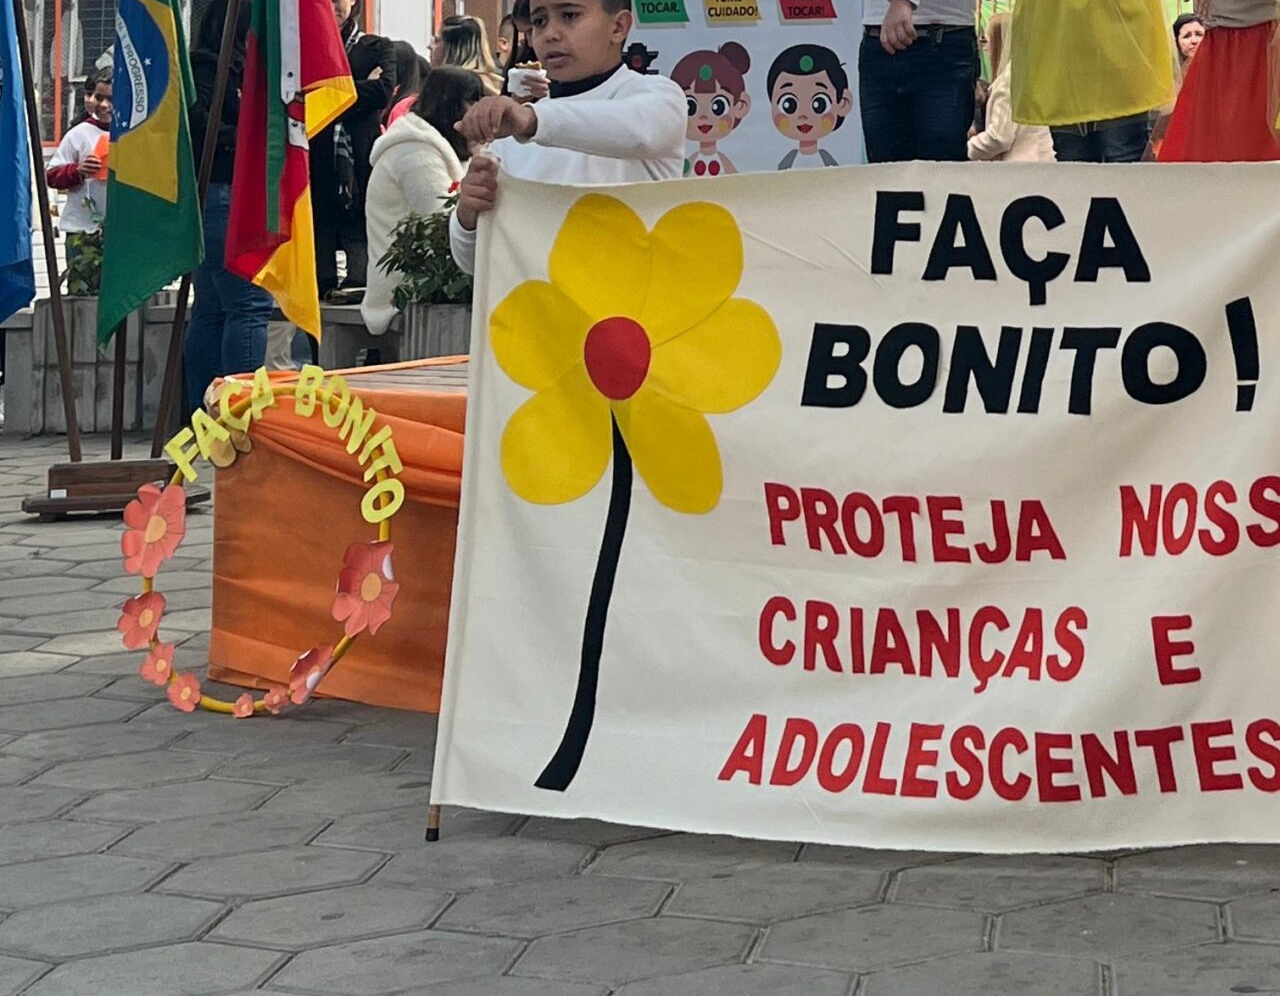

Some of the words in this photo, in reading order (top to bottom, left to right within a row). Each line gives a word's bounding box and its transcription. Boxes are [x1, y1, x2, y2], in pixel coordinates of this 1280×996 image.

[640, 2, 680, 15] TOCAR.
[708, 6, 758, 18] CUIDADO!
[788, 5, 825, 16] TOCAR!
[124, 44, 145, 113] PROGRESSO
[871, 191, 1150, 305] FAÇA
[294, 364, 405, 523] BONITO
[764, 483, 1066, 563] PROTEJA
[759, 596, 1087, 693] CRIANÇAS
[1152, 615, 1202, 686] E
